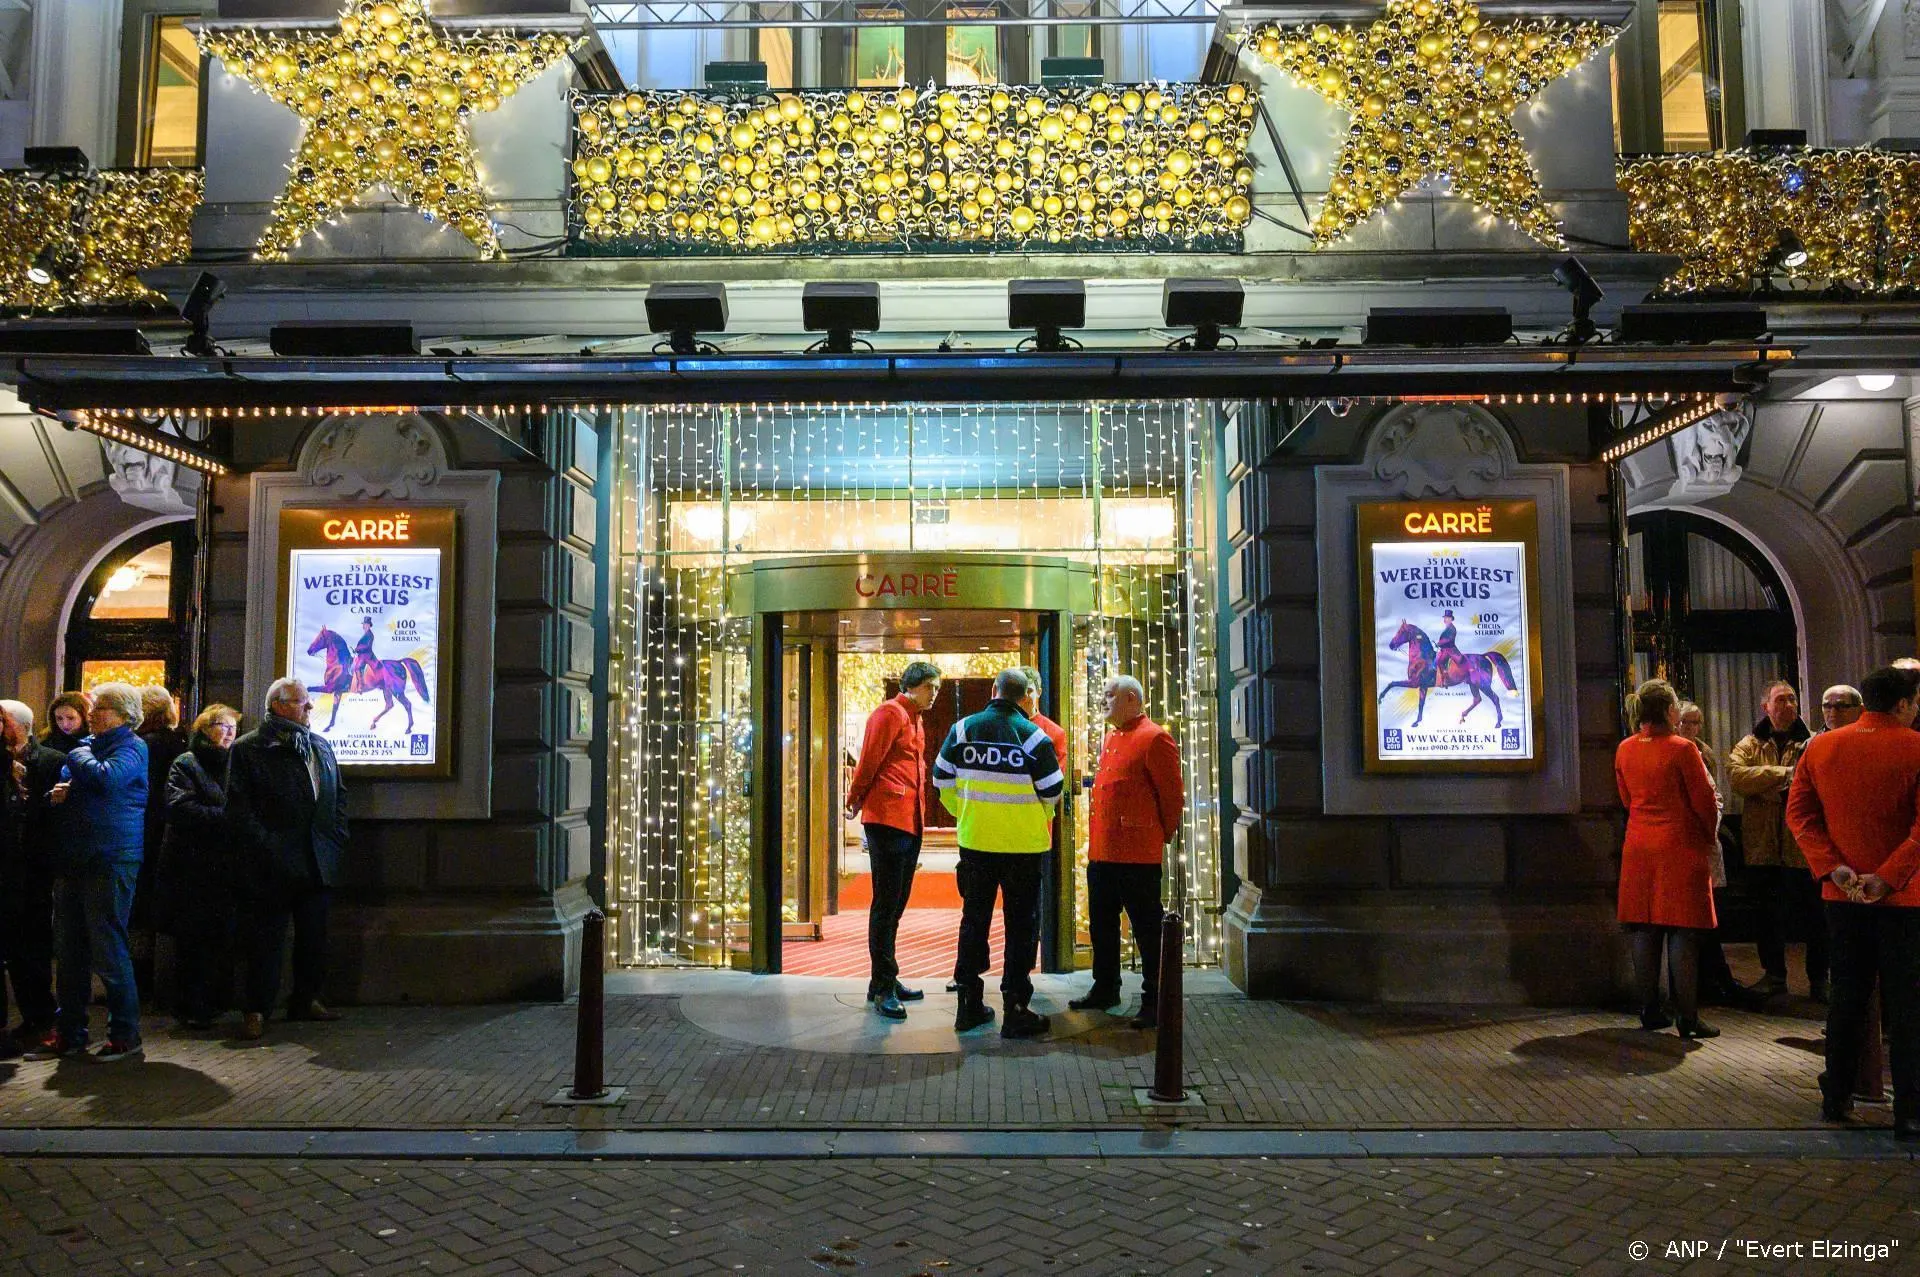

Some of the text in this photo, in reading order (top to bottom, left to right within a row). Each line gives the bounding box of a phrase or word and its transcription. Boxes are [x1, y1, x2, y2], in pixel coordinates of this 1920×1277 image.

[364, 564, 388, 572] JAAR
[1440, 558, 1466, 566] JAAR
[304, 573, 432, 590] WERELDKERST
[1380, 566, 1514, 584] WERELDKERST
[326, 588, 410, 606] CIRCUS
[1404, 582, 1491, 600] CIRCUS
[396, 620, 416, 628] 100
[1479, 613, 1498, 622] 100
[963, 746, 1024, 767] OvD-G
